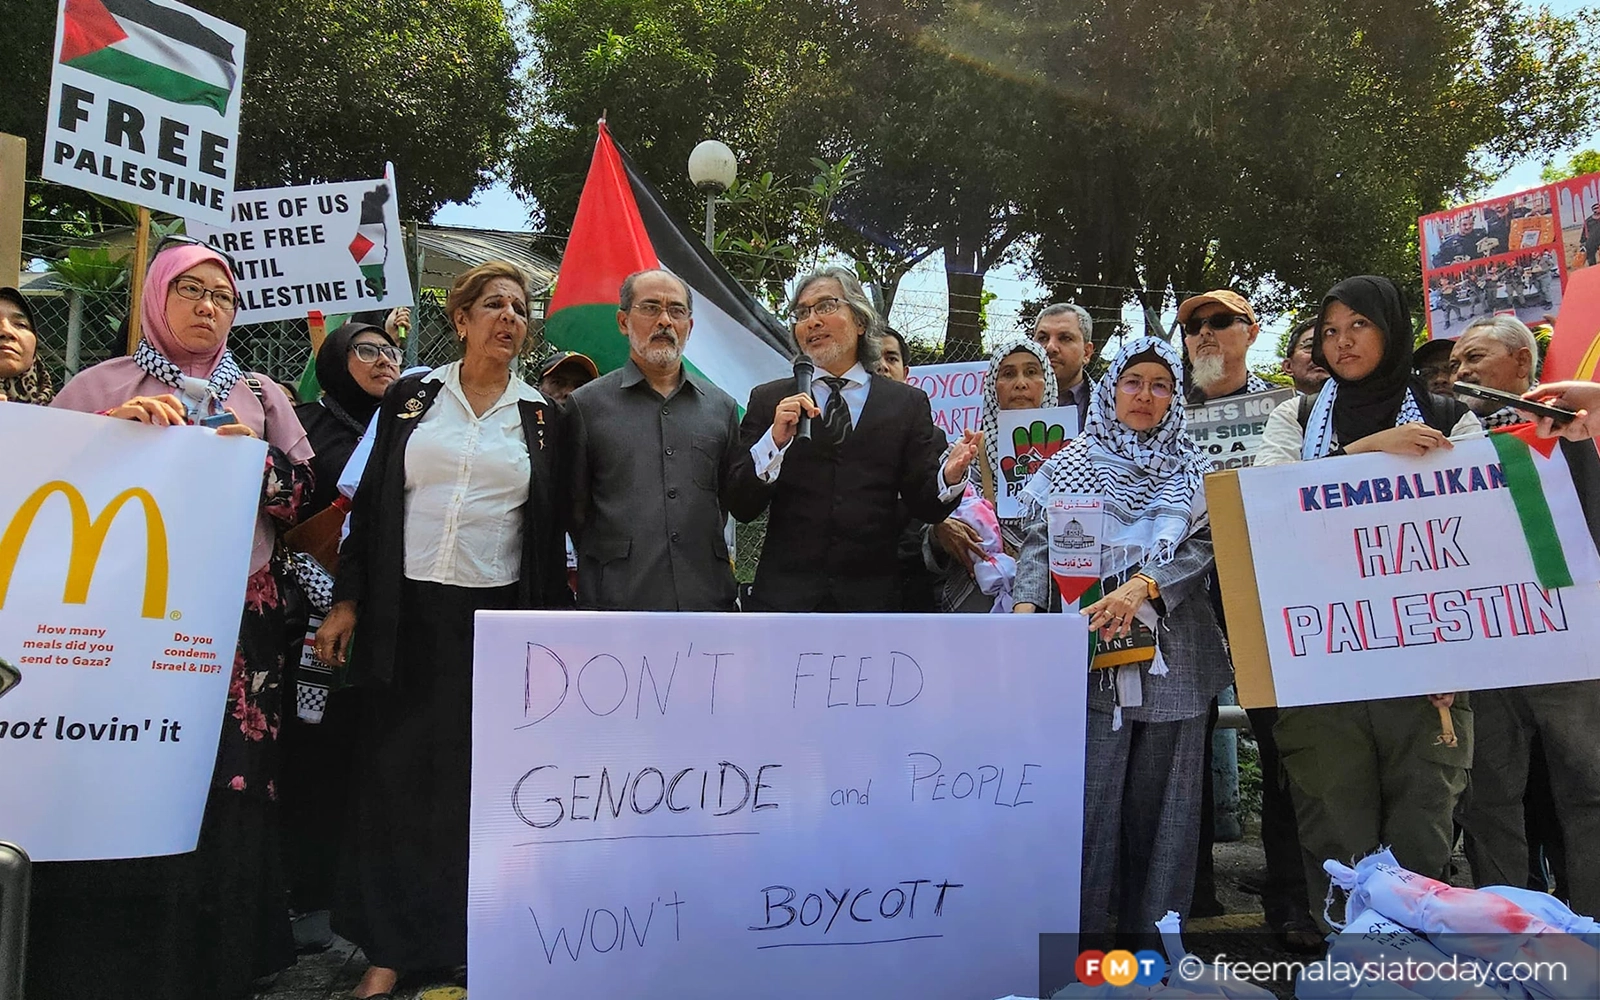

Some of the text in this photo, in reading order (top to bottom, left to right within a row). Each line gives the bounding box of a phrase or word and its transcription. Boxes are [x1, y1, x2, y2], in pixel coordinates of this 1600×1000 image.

[58, 83, 229, 179] FREE
[53, 140, 225, 211] PALESTINE
[278, 197, 307, 218] OF
[318, 194, 349, 214] US
[263, 224, 325, 249] FREE
[233, 257, 284, 282] NTIL
[236, 276, 388, 311] ALESTINE IS!
[1187, 397, 1276, 424] ERE'S NO
[1230, 441, 1246, 452] A
[1299, 463, 1509, 512] KEMBALIKAN
[1354, 516, 1470, 578] HAK
[37, 624, 106, 639] How many
[1283, 581, 1569, 657] PALESTIN
[23, 639, 114, 653] meals did you
[174, 632, 213, 645] Do you
[20, 655, 111, 667] send to Gaza?
[151, 660, 222, 674] Israel & IDF?
[164, 647, 217, 660] condemn
[514, 642, 924, 730] DON'T FEED
[55, 716, 151, 742] lovin'
[159, 718, 182, 743] it
[512, 753, 1042, 829] GENOCIDE and PEOPLE
[747, 879, 963, 934] BOYCOTT
